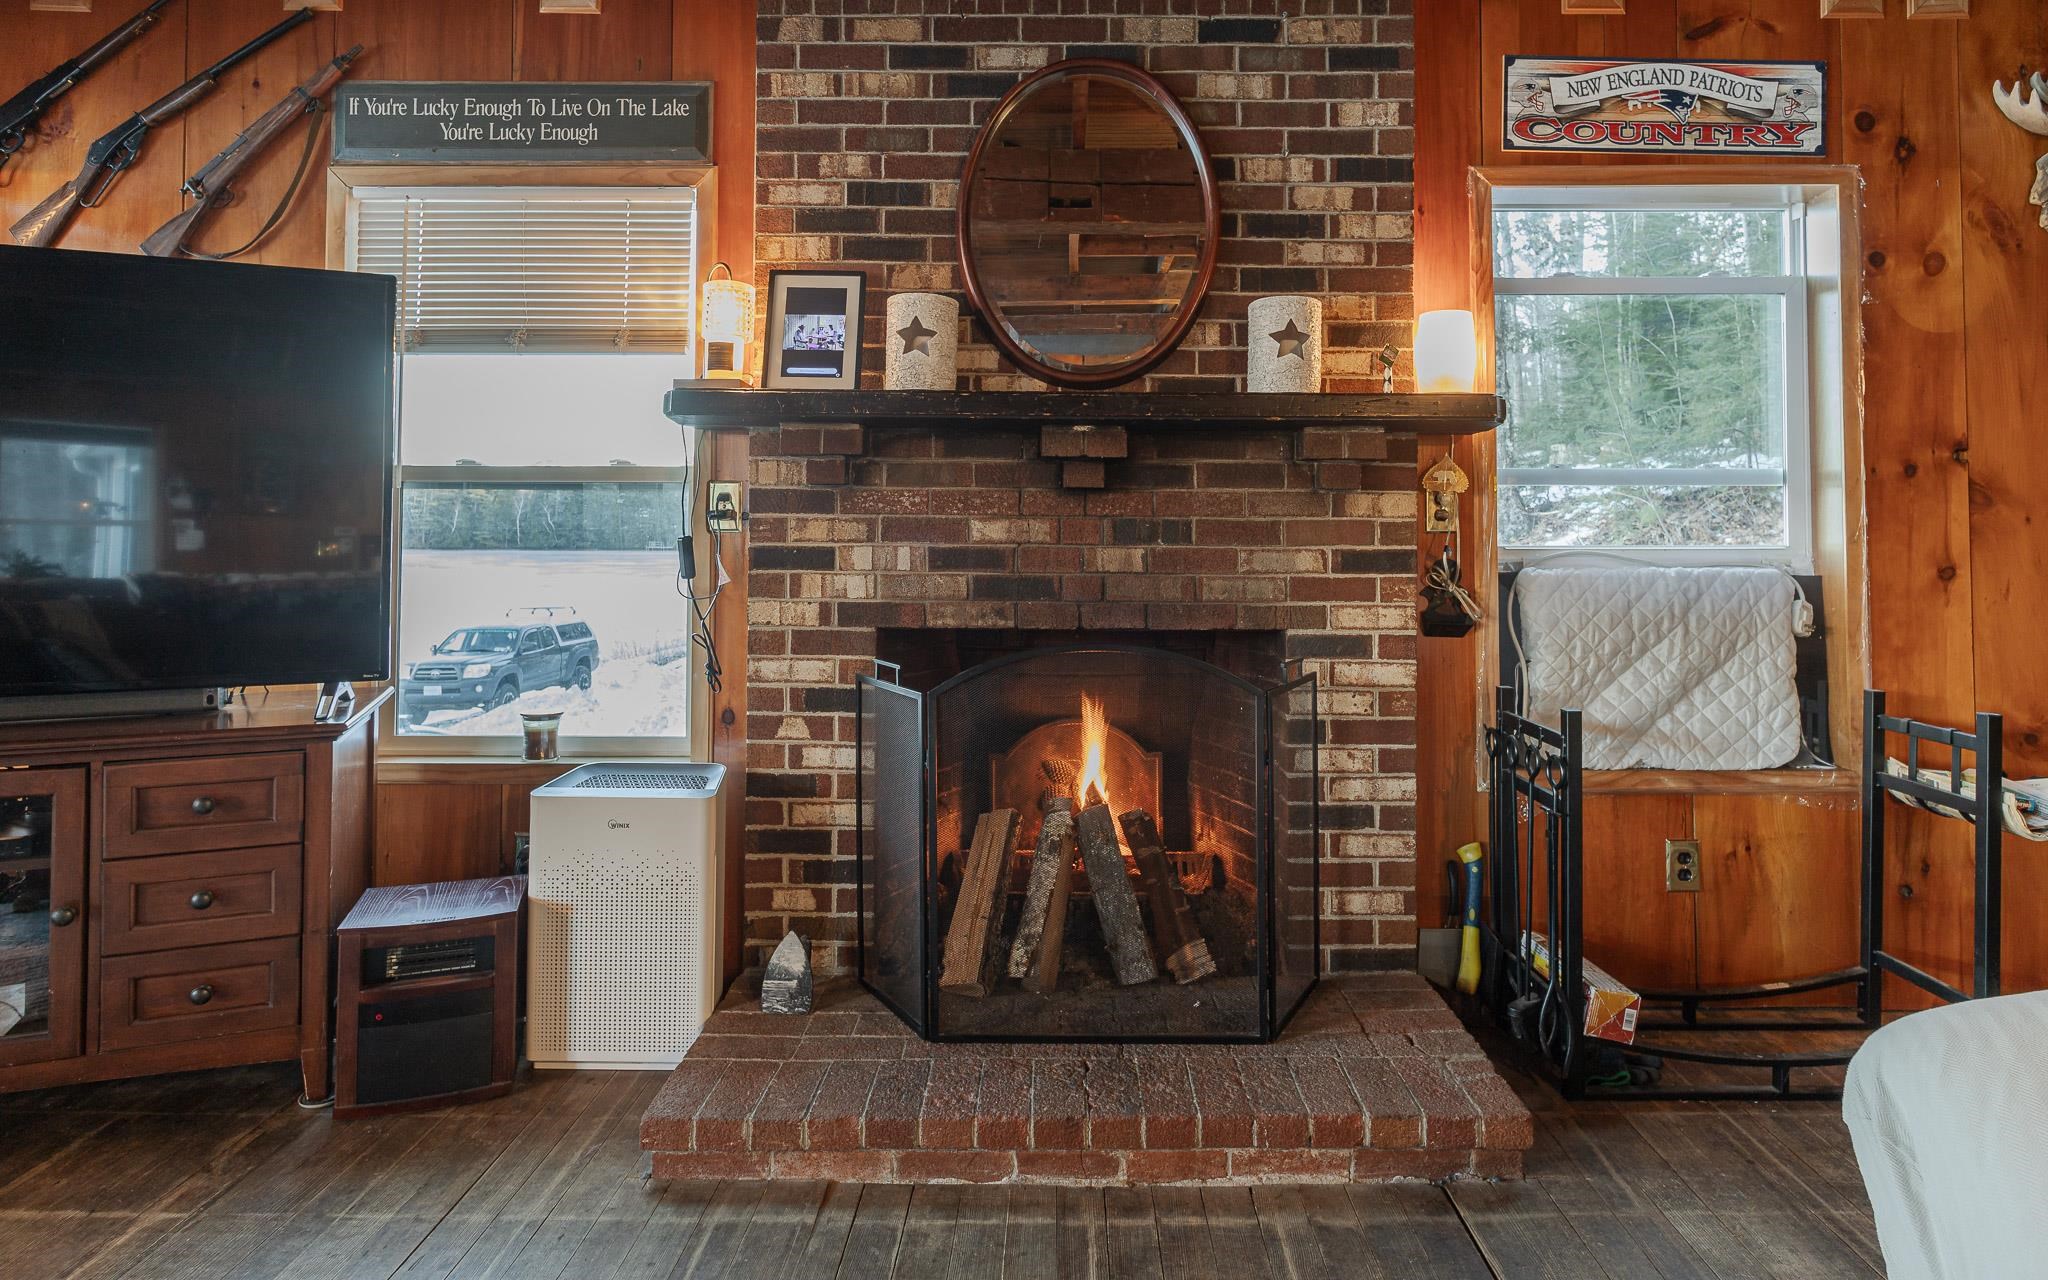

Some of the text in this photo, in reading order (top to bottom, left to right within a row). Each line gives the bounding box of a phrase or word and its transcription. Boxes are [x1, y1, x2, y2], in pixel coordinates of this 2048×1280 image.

[1567, 67, 1764, 103] NEW ENGLAND PATRIOTS
[349, 96, 690, 121] If You're Lucky Enough To Live On The Lake
[440, 122, 599, 146] You're Lucky Enough
[1512, 114, 1818, 148] COUNTRY
[608, 819, 630, 829] WINIX
